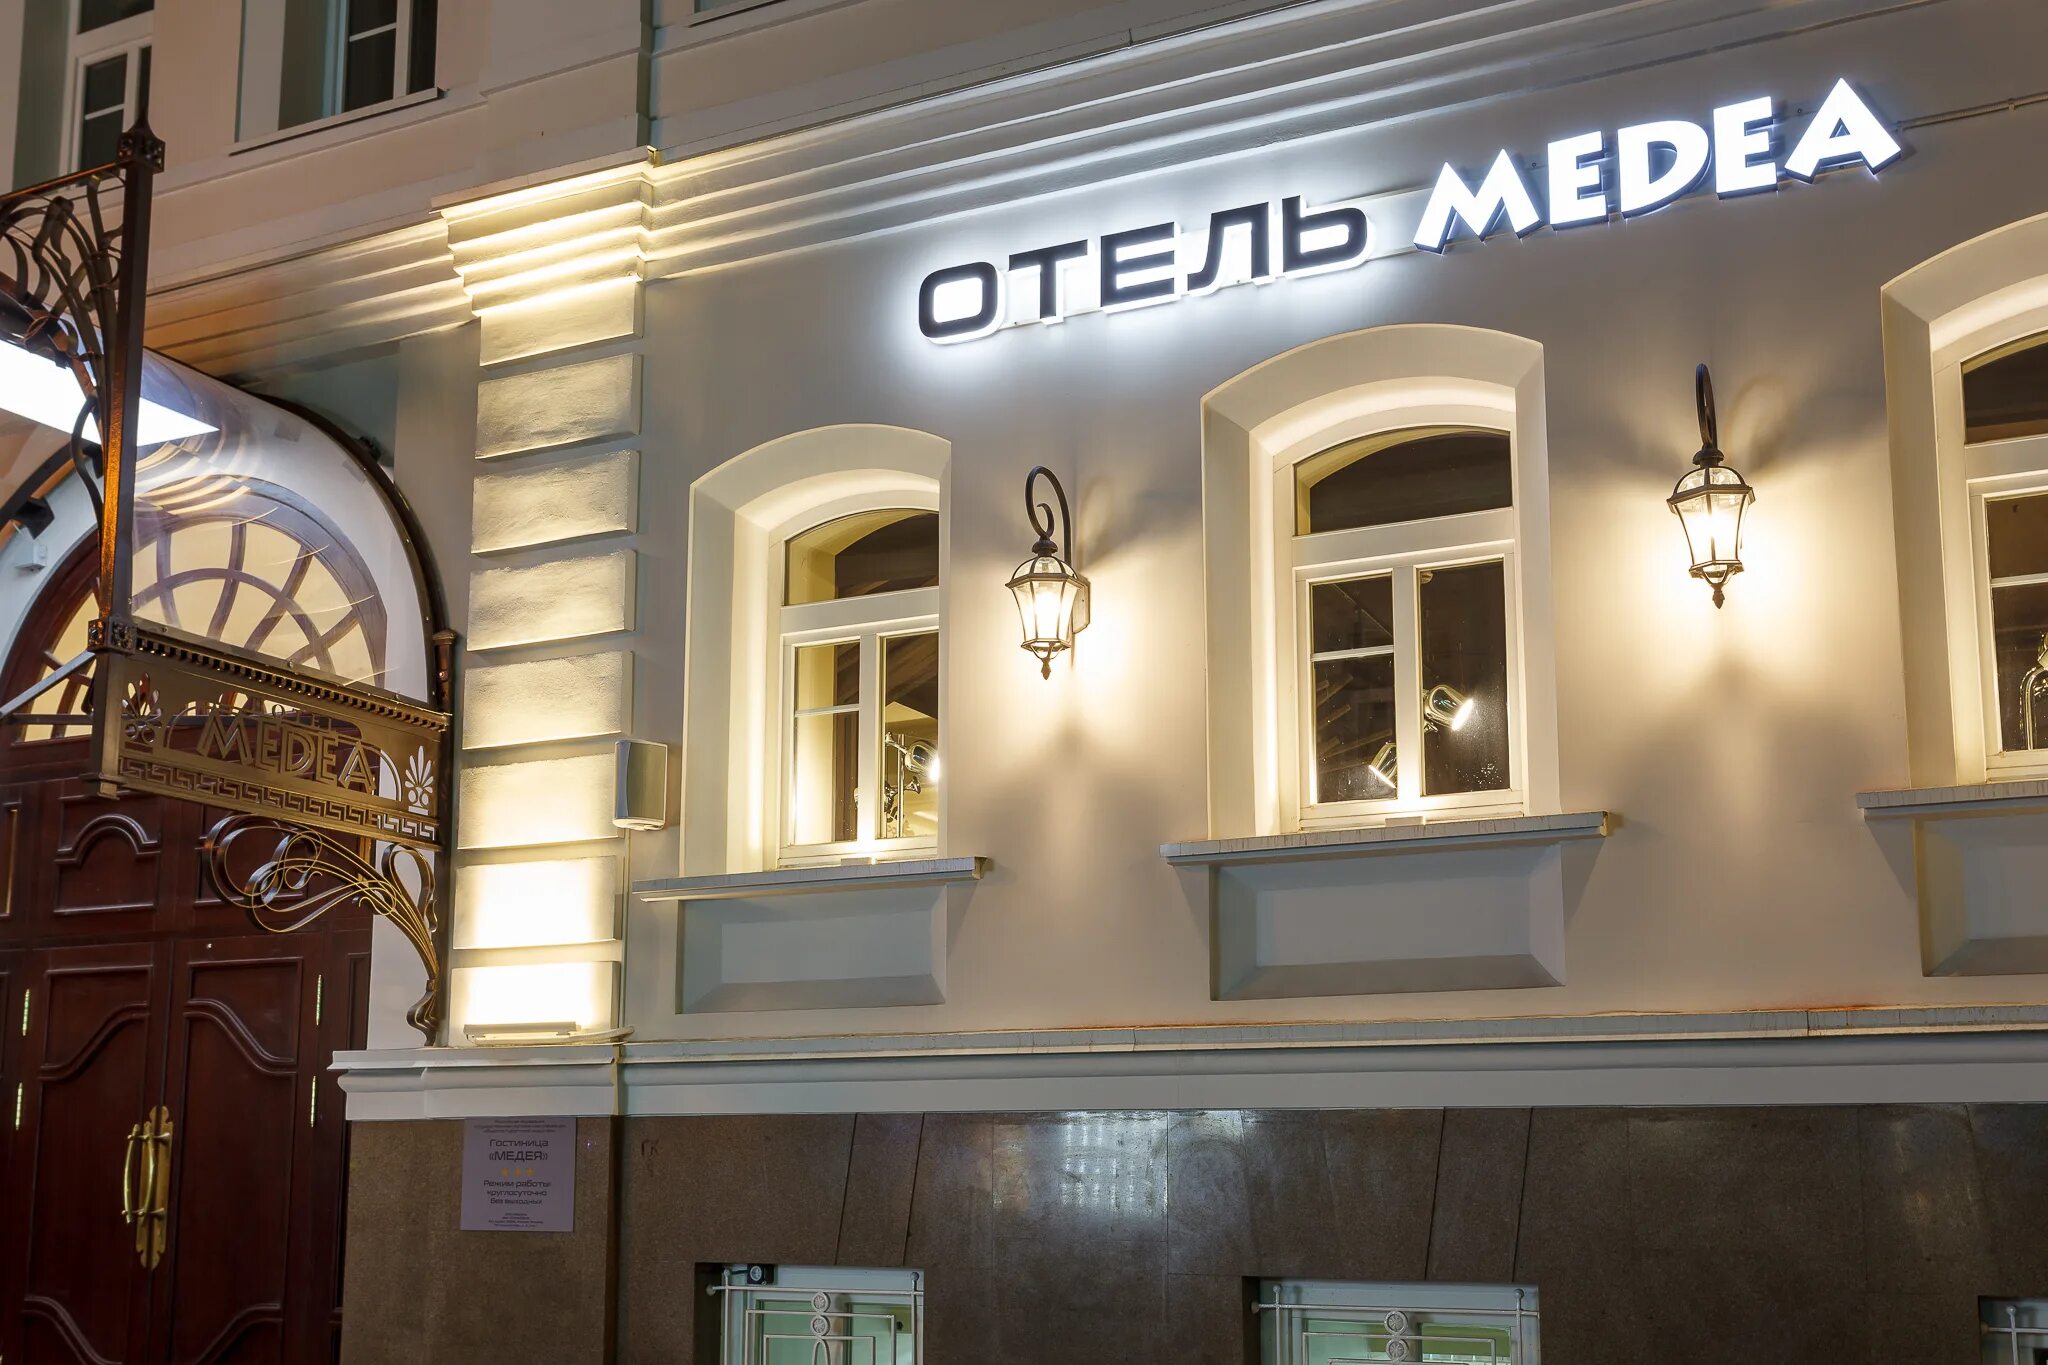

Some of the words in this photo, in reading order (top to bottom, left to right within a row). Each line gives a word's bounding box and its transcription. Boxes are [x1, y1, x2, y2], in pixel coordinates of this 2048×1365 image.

[918, 195, 1369, 341] ОТЕЛЬ
[1412, 77, 1901, 253] MEDEA
[196, 705, 375, 793] MEDEA
[489, 1138, 549, 1148] Гостиница
[489, 1151, 548, 1162] «МЕДЕЯ»
